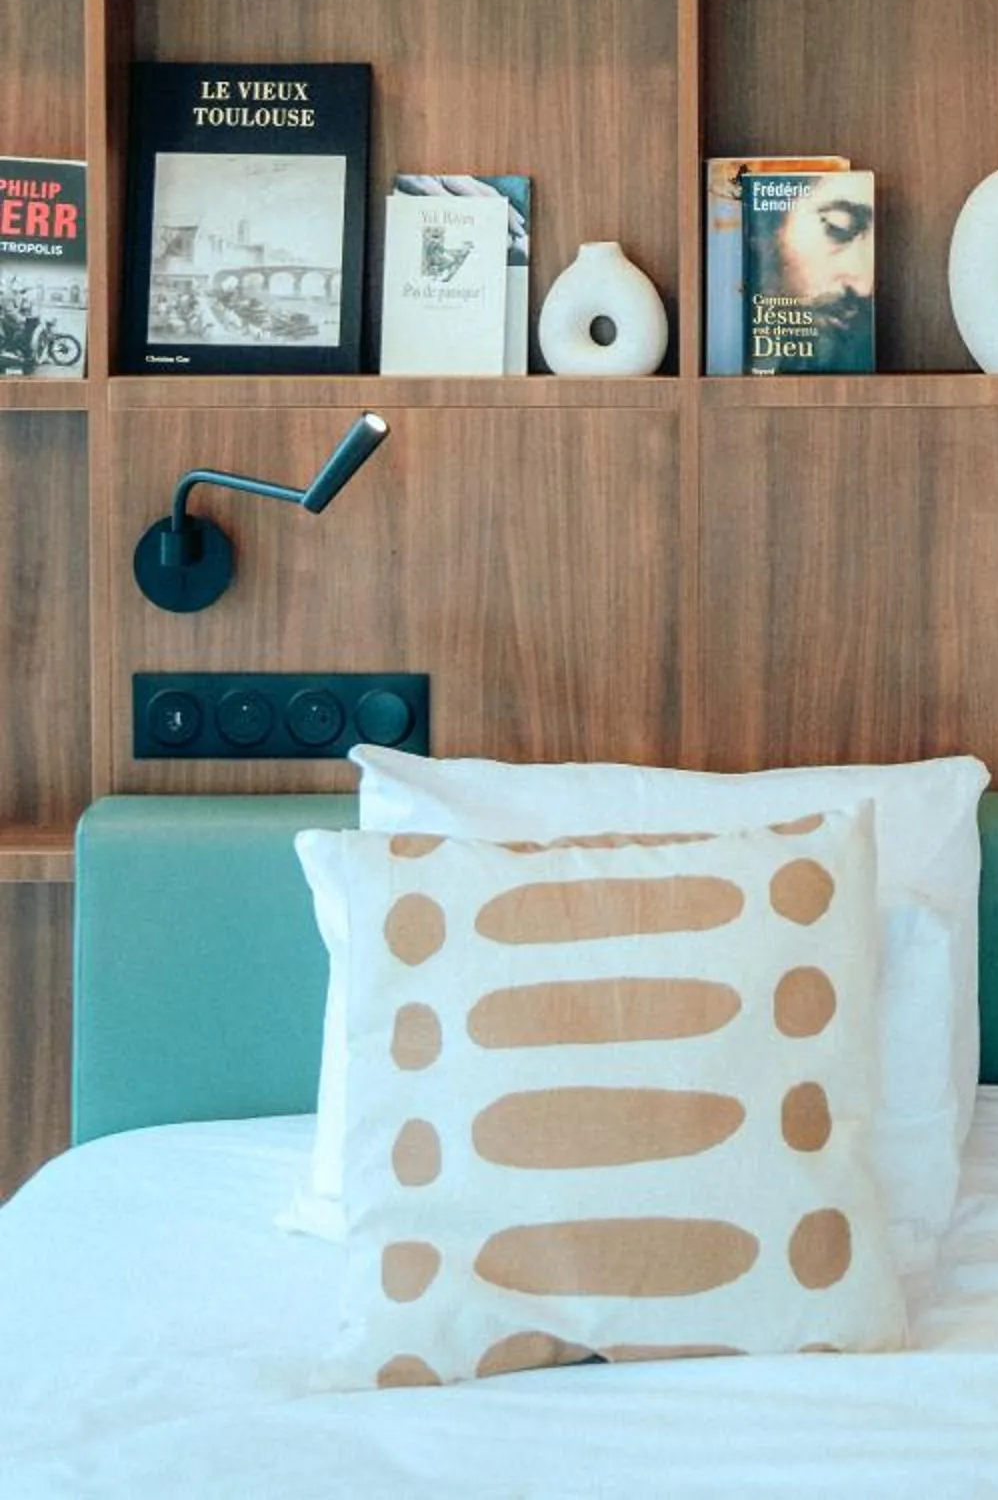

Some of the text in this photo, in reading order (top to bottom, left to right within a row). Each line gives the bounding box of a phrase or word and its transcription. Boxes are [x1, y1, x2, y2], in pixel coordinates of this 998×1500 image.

[201, 81, 309, 101] LE VIEUX
[193, 107, 315, 127] TOULOUSE
[753, 181, 811, 197] Frédéric
[0, 200, 78, 240] ERR
[753, 307, 814, 325] Jésus
[753, 326, 769, 336] est
[753, 336, 814, 357] Dieu
